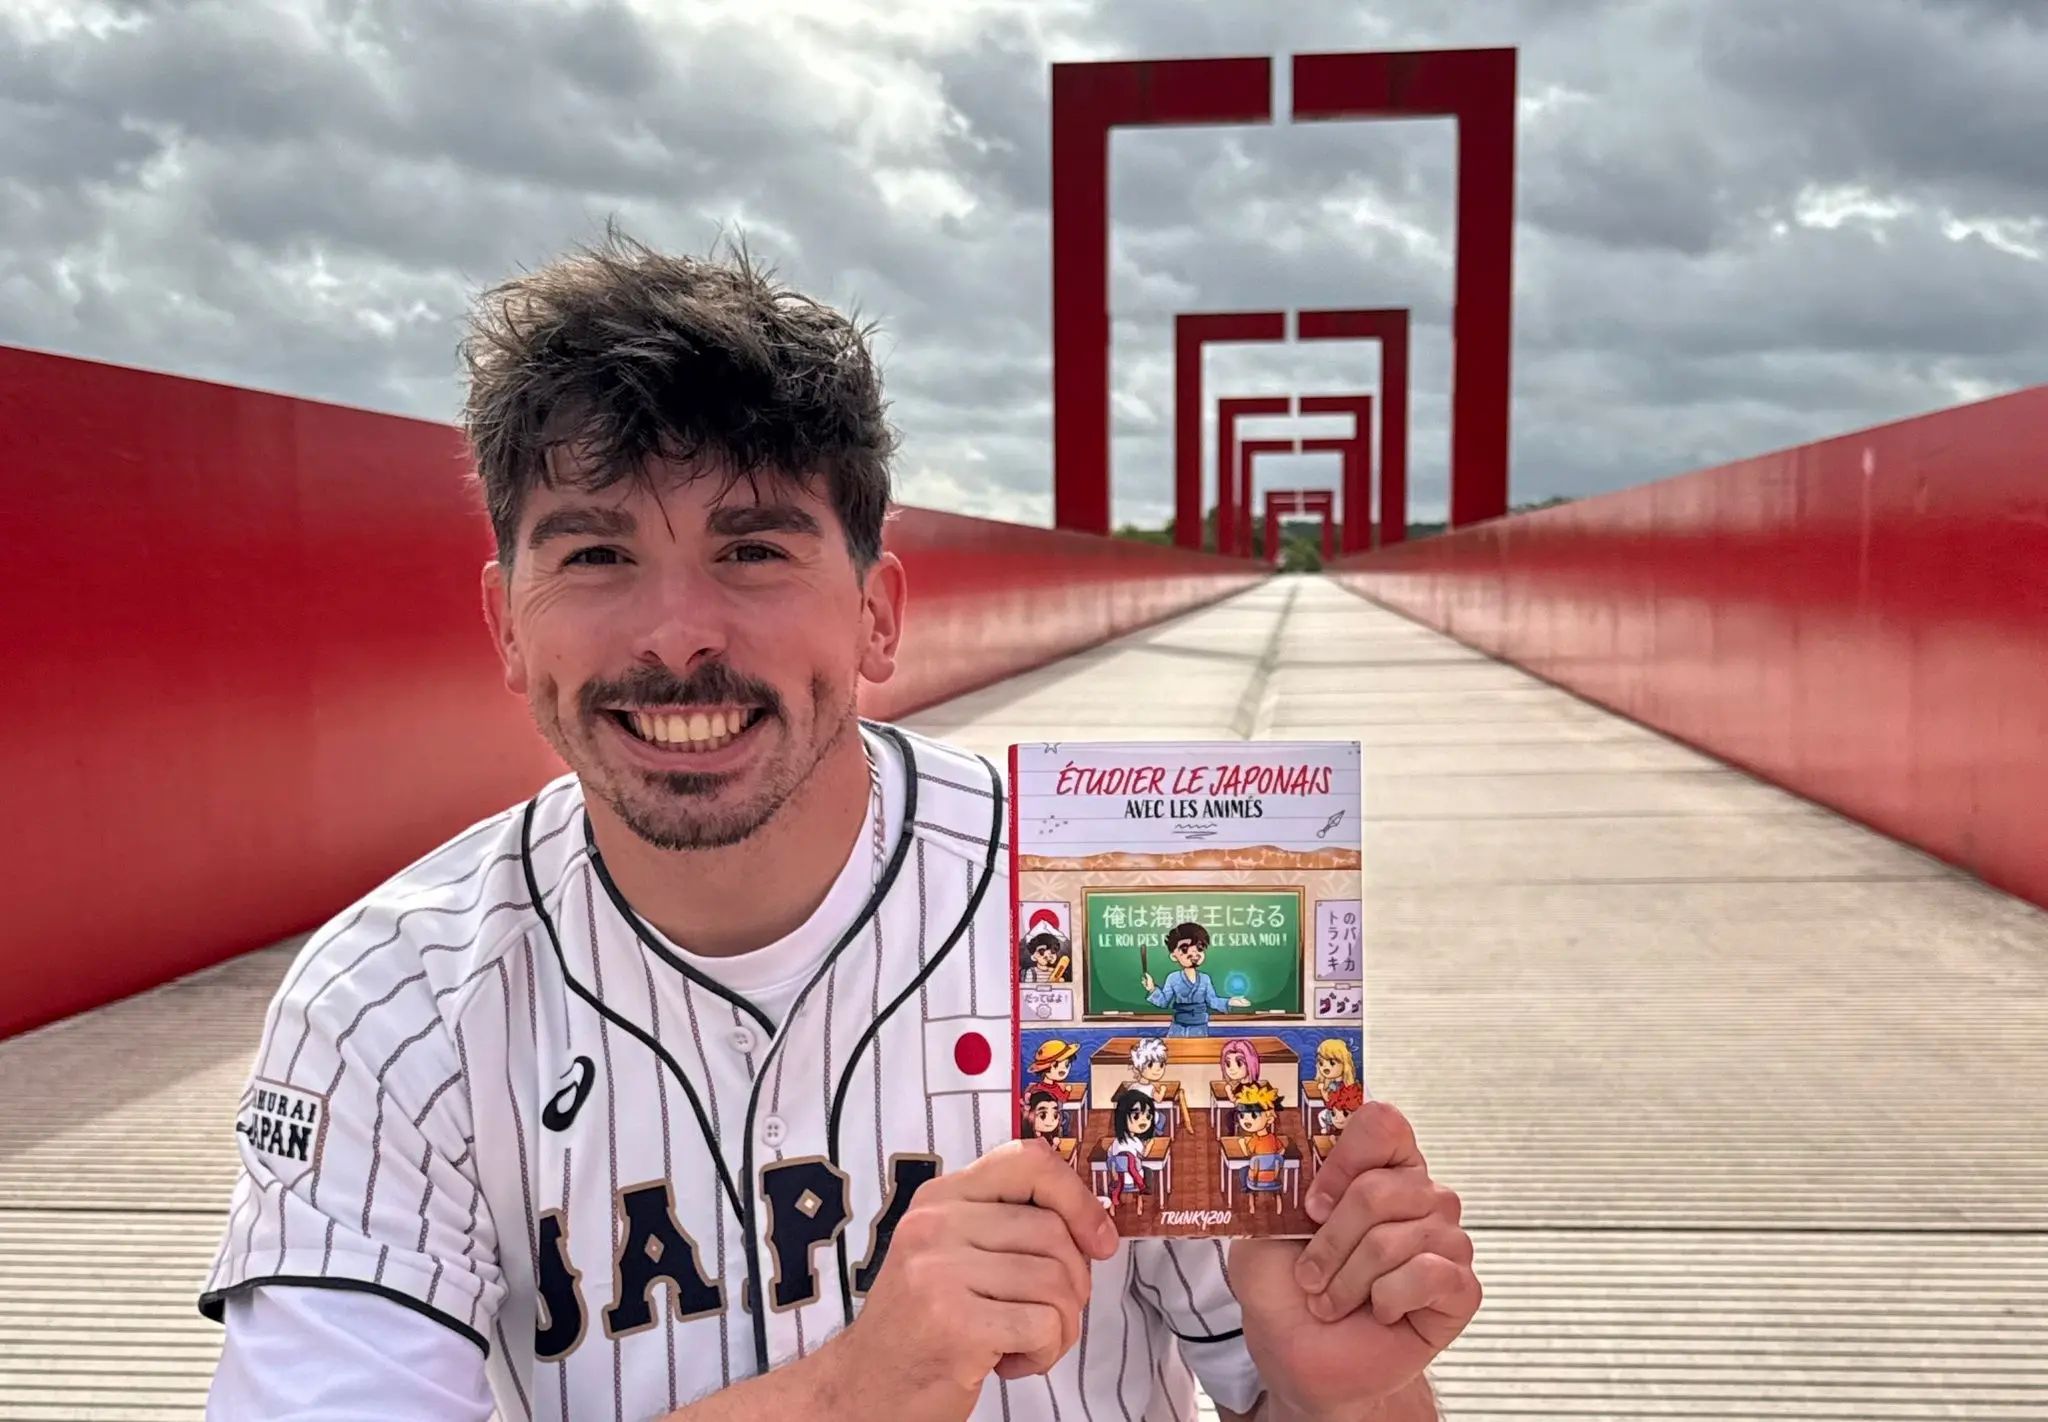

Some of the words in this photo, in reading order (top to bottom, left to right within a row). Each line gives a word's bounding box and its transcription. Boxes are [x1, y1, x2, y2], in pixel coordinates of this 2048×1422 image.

[1056, 761, 1165, 795] ÉTUDIER
[1172, 766, 1209, 794] LE
[1210, 765, 1332, 797] JAPONAIS
[1124, 799, 1164, 819] AVEC
[1170, 799, 1198, 819] LES
[1203, 796, 1263, 819] ANIMÉS
[1102, 904, 1285, 928] 俺は海賊王になる
[1099, 934, 1113, 947] LE
[1115, 933, 1134, 947] ROI
[1229, 932, 1256, 947] SERA
